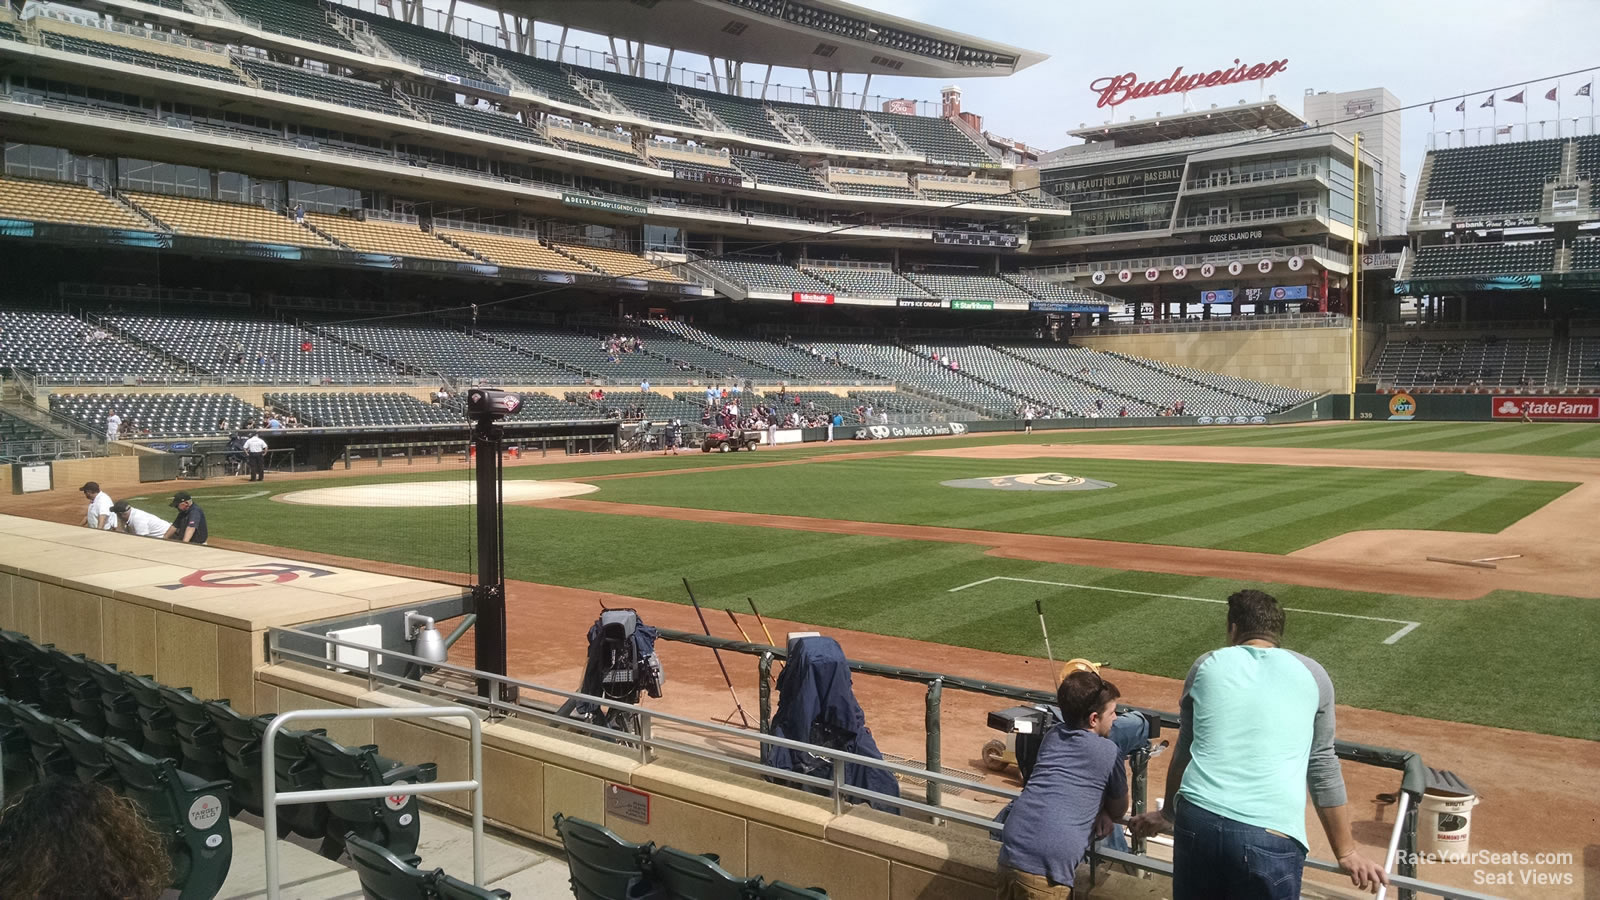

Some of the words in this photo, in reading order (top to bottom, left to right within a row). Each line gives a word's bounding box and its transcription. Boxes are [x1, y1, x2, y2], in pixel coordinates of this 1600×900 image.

[1090, 58, 1288, 108] Budweiser
[1077, 176, 1116, 189] BEAUTIFUL
[1117, 175, 1130, 185] DAY
[1144, 169, 1180, 181] BASEBALL
[571, 197, 590, 205] DELTA
[611, 203, 633, 212] LEGENDS
[1105, 210, 1130, 221] TWINS
[1209, 233, 1227, 242] GOOSE
[1228, 231, 1249, 241] ISLAND
[1250, 230, 1263, 239] PUB
[892, 427, 904, 436] Go
[904, 426, 923, 436] Music
[923, 425, 934, 436] Go
[934, 425, 950, 435] Twins
[191, 806, 219, 817] TARGET
[195, 812, 216, 820] FIELD
